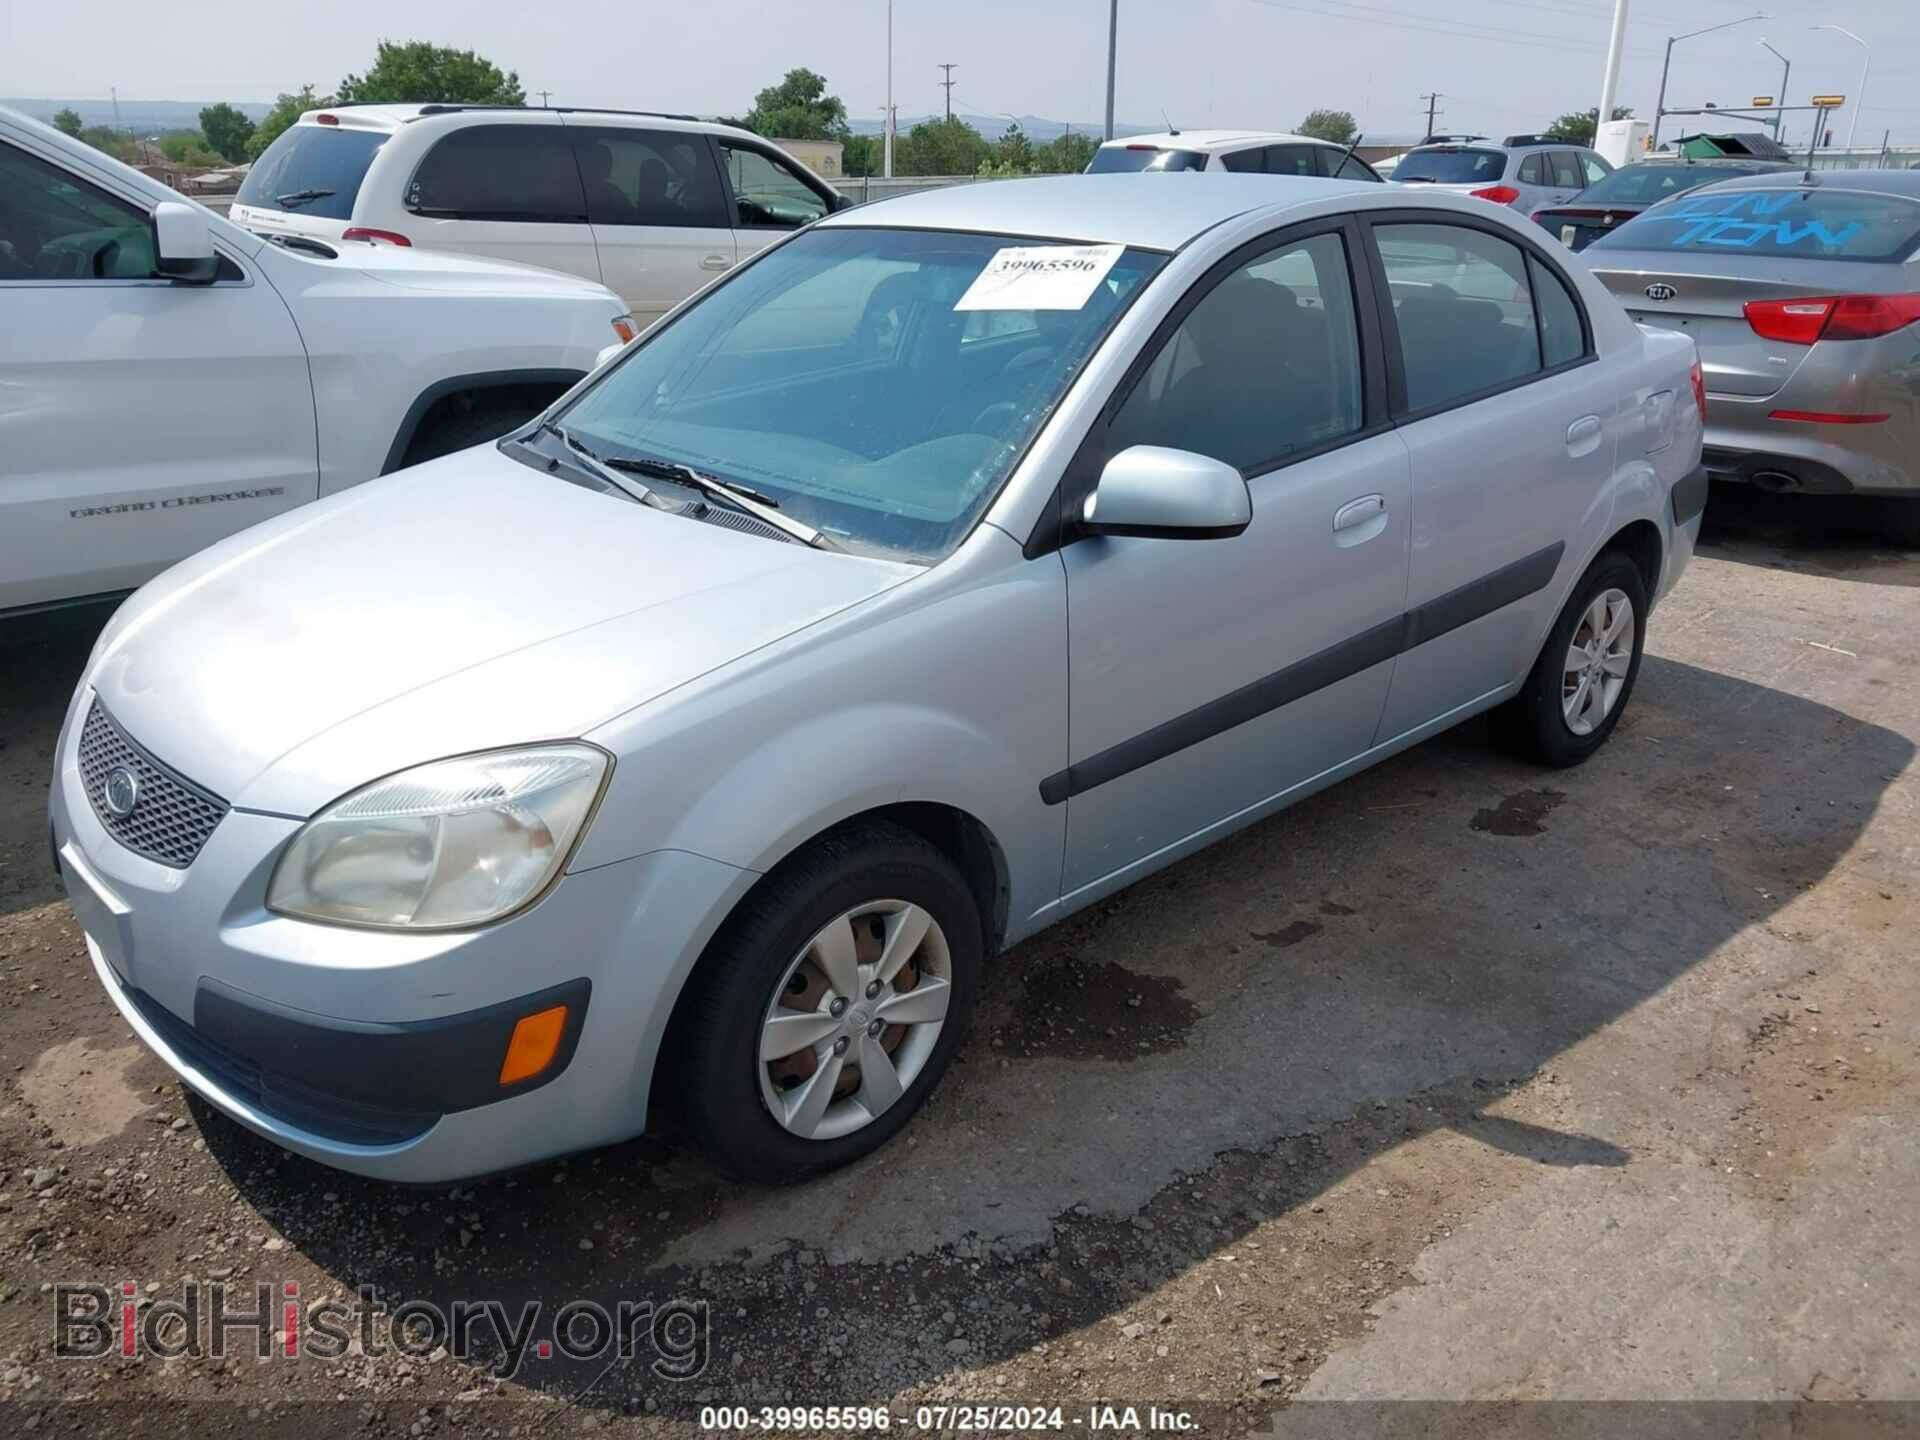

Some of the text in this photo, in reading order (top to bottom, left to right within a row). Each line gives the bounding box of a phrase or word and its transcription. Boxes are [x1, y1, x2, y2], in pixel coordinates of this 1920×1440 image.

[1672, 217, 1863, 246] TOW
[995, 259, 1097, 273] 39965596
[1649, 287, 1670, 298] KIA
[161, 487, 285, 508] CHEROKEE
